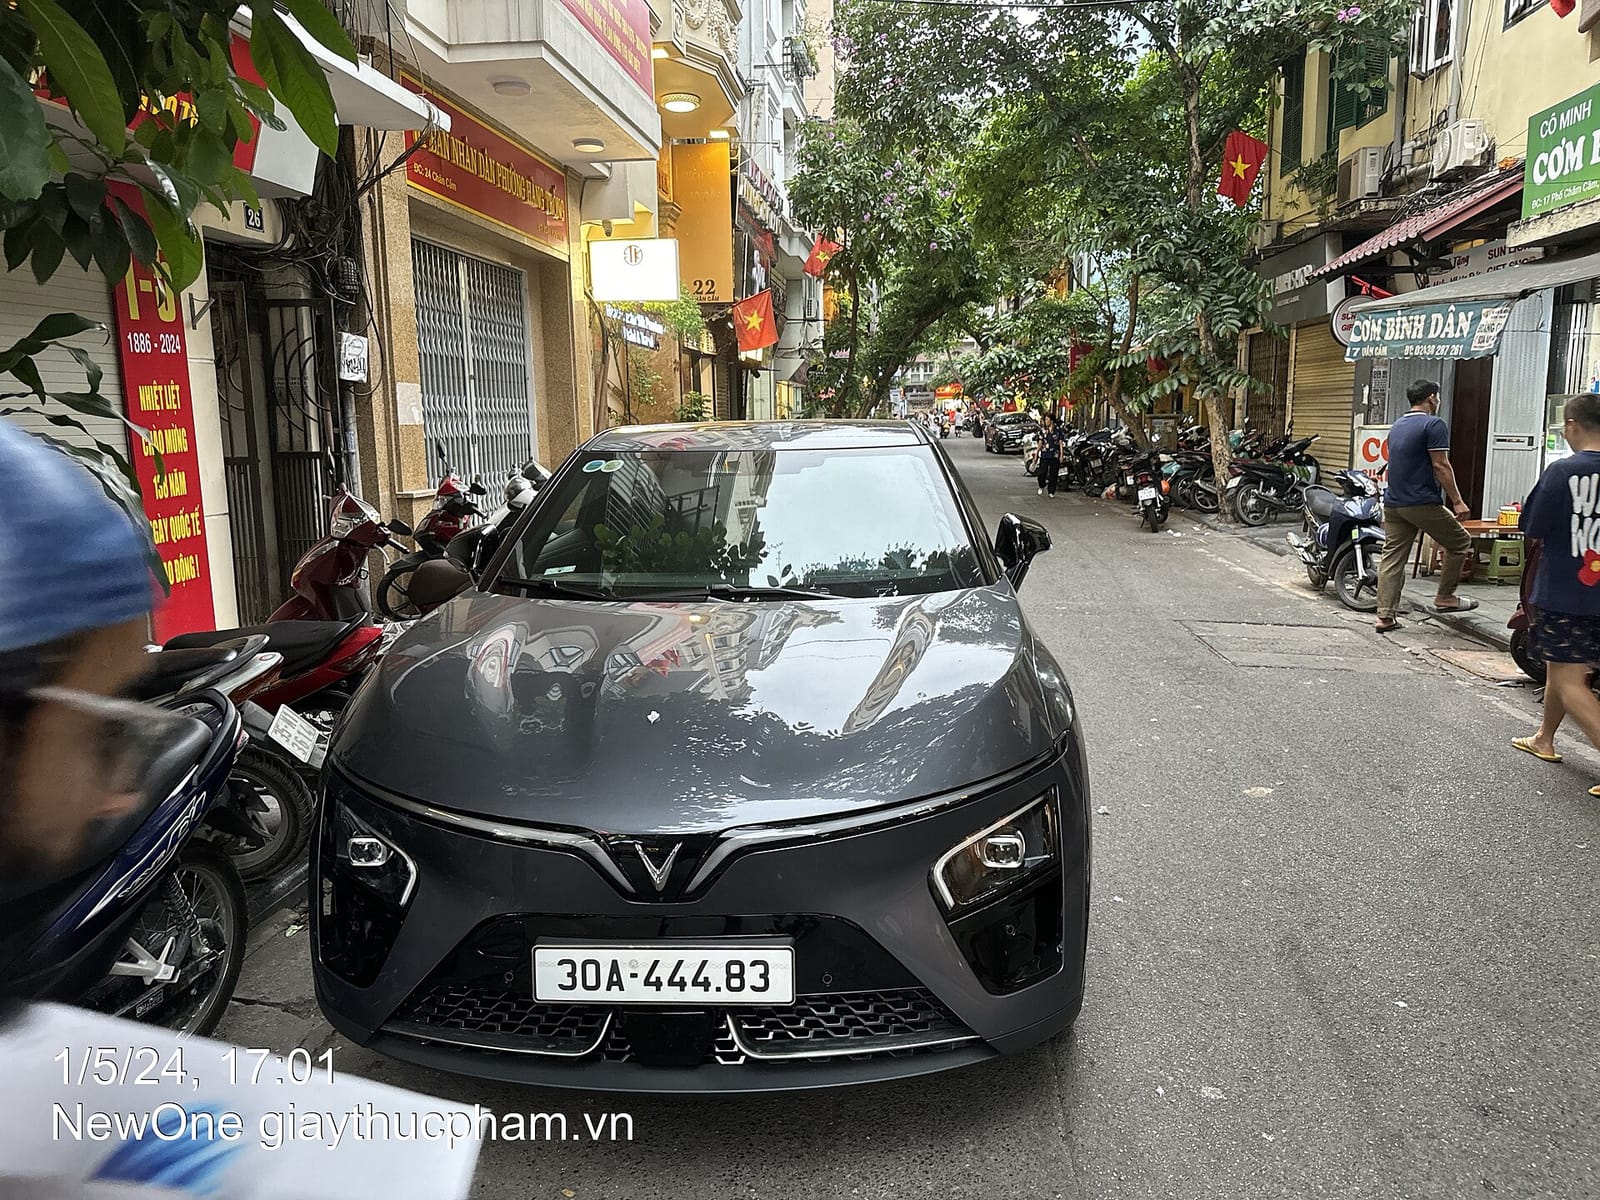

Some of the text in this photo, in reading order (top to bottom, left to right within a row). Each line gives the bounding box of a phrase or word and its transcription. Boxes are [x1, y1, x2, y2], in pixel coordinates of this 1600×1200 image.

[1540, 98, 1593, 139] CÔ MINH
[450, 135, 477, 176] NHÂN
[478, 147, 496, 185] DÂN
[1532, 137, 1586, 186] CƠM
[1543, 195, 1551, 206] 17
[247, 208, 261, 228] 26
[1487, 246, 1506, 260] SUN
[693, 279, 716, 295] 22
[1350, 315, 1382, 343] CƠM
[1384, 310, 1425, 341] BÌNH
[1427, 304, 1473, 339] DÂN
[127, 331, 152, 354] 1886
[159, 333, 182, 354] 2024
[1346, 347, 1361, 357] 17
[138, 379, 182, 416] NHIỆT LIỆT
[164, 422, 188, 455] MỪNG
[168, 466, 187, 498] NĂM
[149, 503, 202, 545] GÀY QUỐC TẾ
[173, 552, 196, 588] ĐỘNG
[557, 959, 770, 992] 30A-444.83
